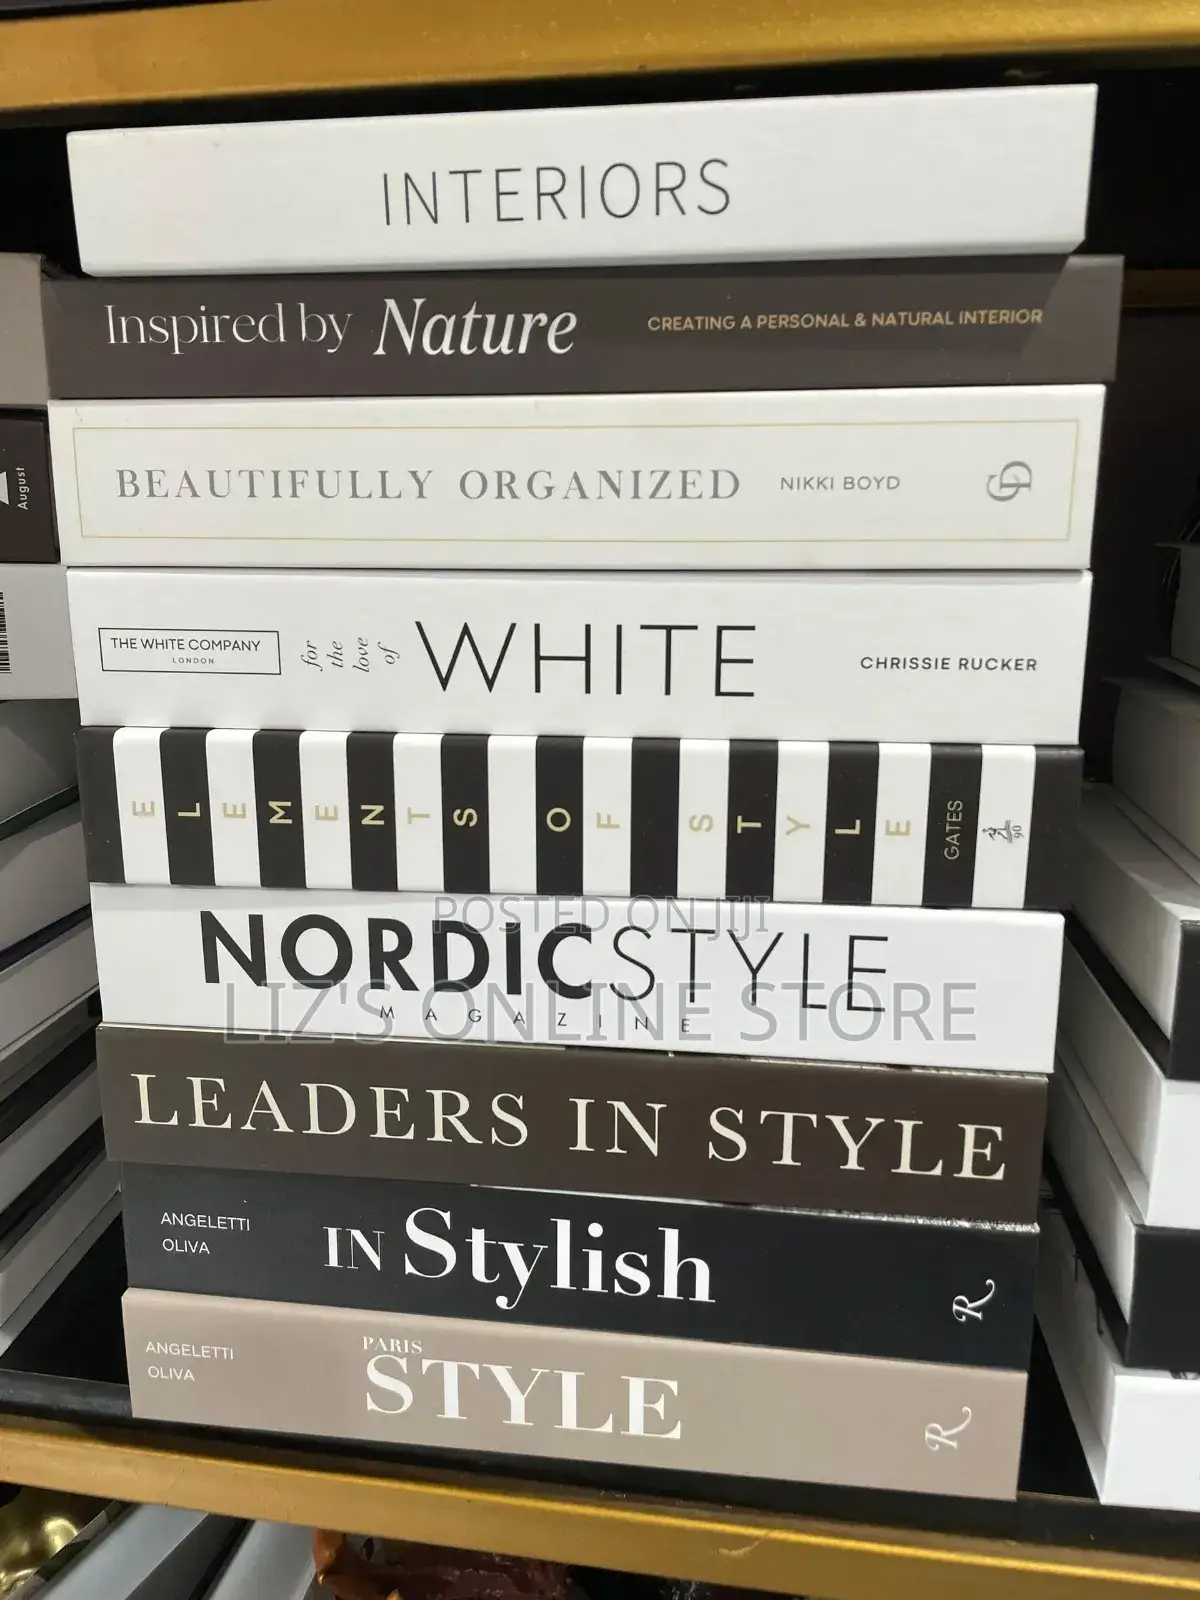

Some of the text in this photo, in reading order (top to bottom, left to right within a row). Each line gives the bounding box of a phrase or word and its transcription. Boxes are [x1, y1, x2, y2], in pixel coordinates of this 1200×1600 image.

[382, 158, 731, 226] INTERIORS
[104, 297, 579, 357] Inspired by Nature
[646, 307, 1045, 334] CREATING A PERSONAL & NATURAL INTERIOR
[15, 464, 29, 511] August
[115, 467, 742, 501] BEAUTIFULLY ORGANIZED
[779, 474, 901, 492] NIKKI BOYD
[110, 636, 261, 652] THE WHITE COMPANY
[300, 639, 324, 671] for
[328, 639, 345, 669] the
[352, 636, 370, 673] love
[380, 641, 401, 666] of
[414, 620, 756, 698] WHITE
[171, 656, 215, 664] LONDON
[860, 655, 1038, 673] CHRISSIE RUCKER
[943, 799, 964, 861] GATES
[131, 1073, 1006, 1182] LEADERS IN STYLE
[160, 1212, 250, 1232] ANGELETTI
[162, 1238, 210, 1255] OLIVA
[323, 1207, 716, 1311] IN Stylish
[145, 1341, 234, 1361] ANGELETTI
[362, 1335, 423, 1354] PARIS
[147, 1365, 195, 1381] OLIVA
[366, 1353, 682, 1441] STYLE
